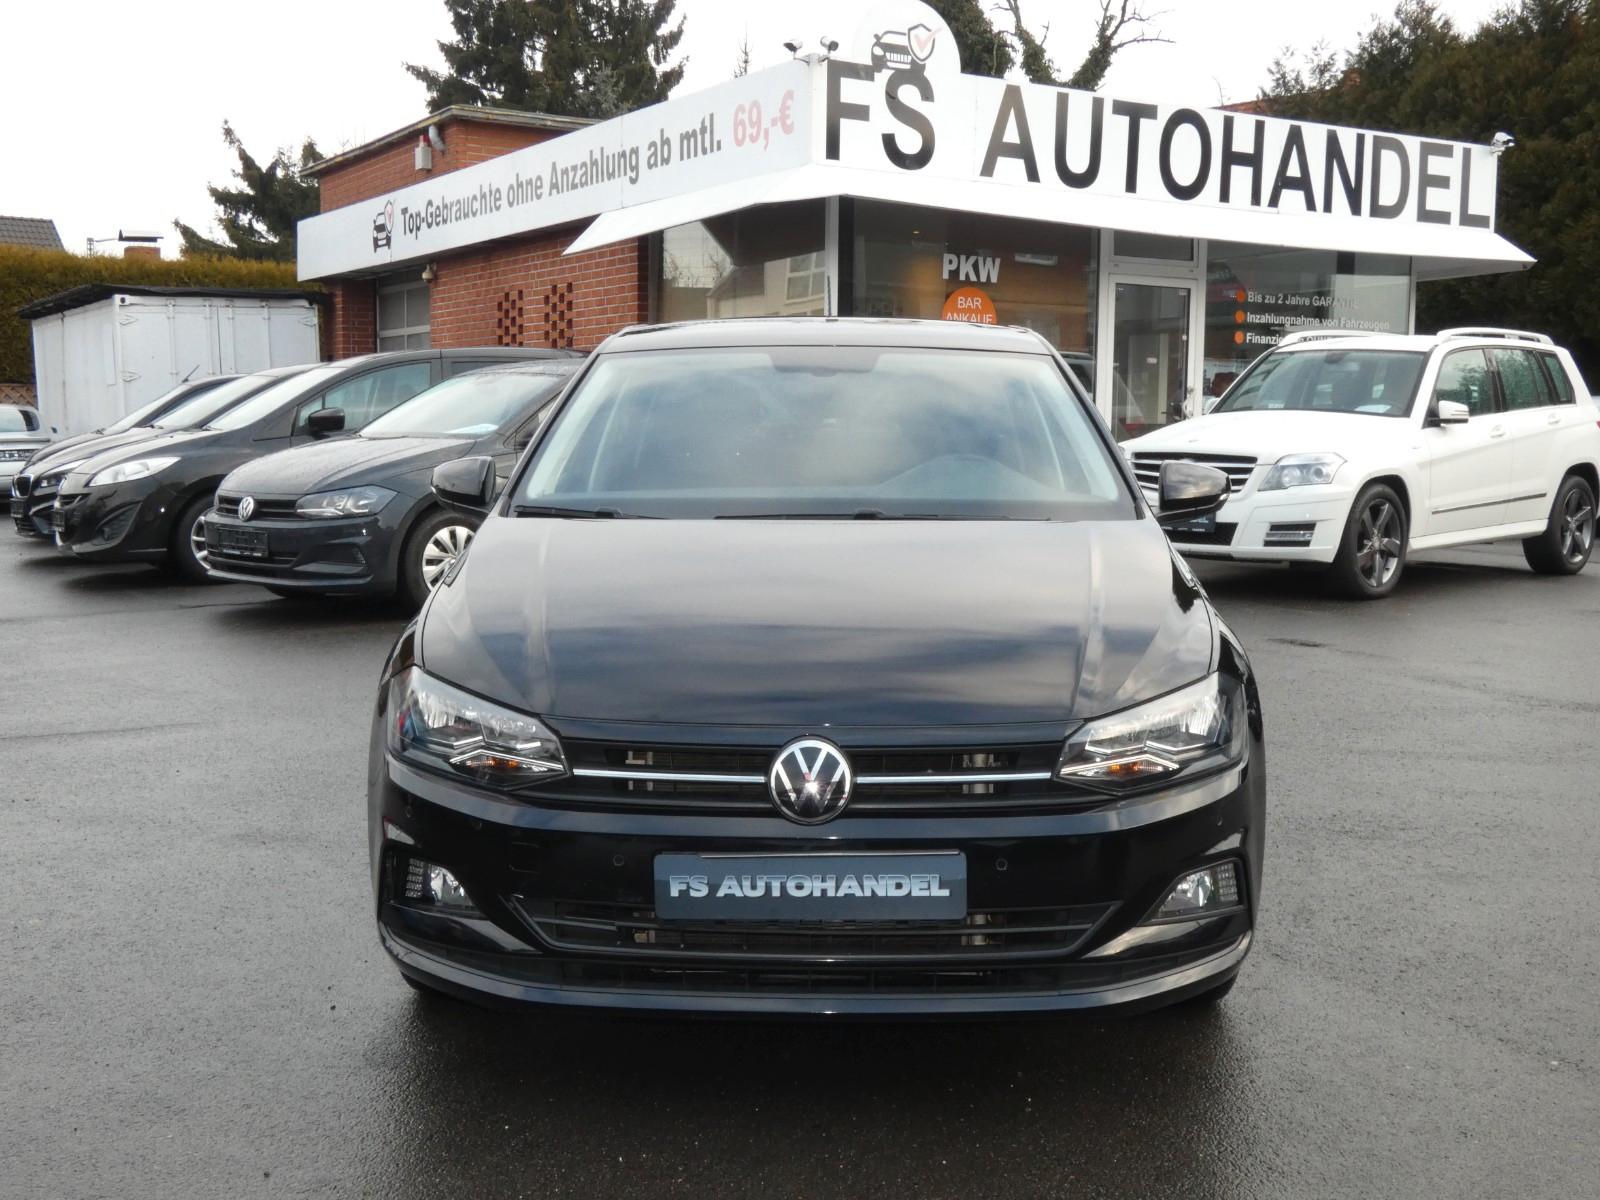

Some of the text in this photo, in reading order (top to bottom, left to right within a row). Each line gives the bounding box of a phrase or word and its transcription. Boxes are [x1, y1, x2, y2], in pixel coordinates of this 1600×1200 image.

[825, 59, 1491, 229] FS AUTOHANDEL
[400, 89, 795, 240] Top-Gebrauchte ohne Anzahlung ab mtl. 69,-€
[942, 253, 1002, 283] PKW
[957, 296, 982, 309] BAR
[1247, 291, 1263, 303] Bis
[1264, 294, 1276, 304] zu
[1277, 294, 1284, 304] 2
[1285, 294, 1311, 306] Jahre
[1246, 311, 1390, 332] Inzahlungnahme von Fahrzeugen
[669, 873, 951, 898] FS AUTOHANDEL
